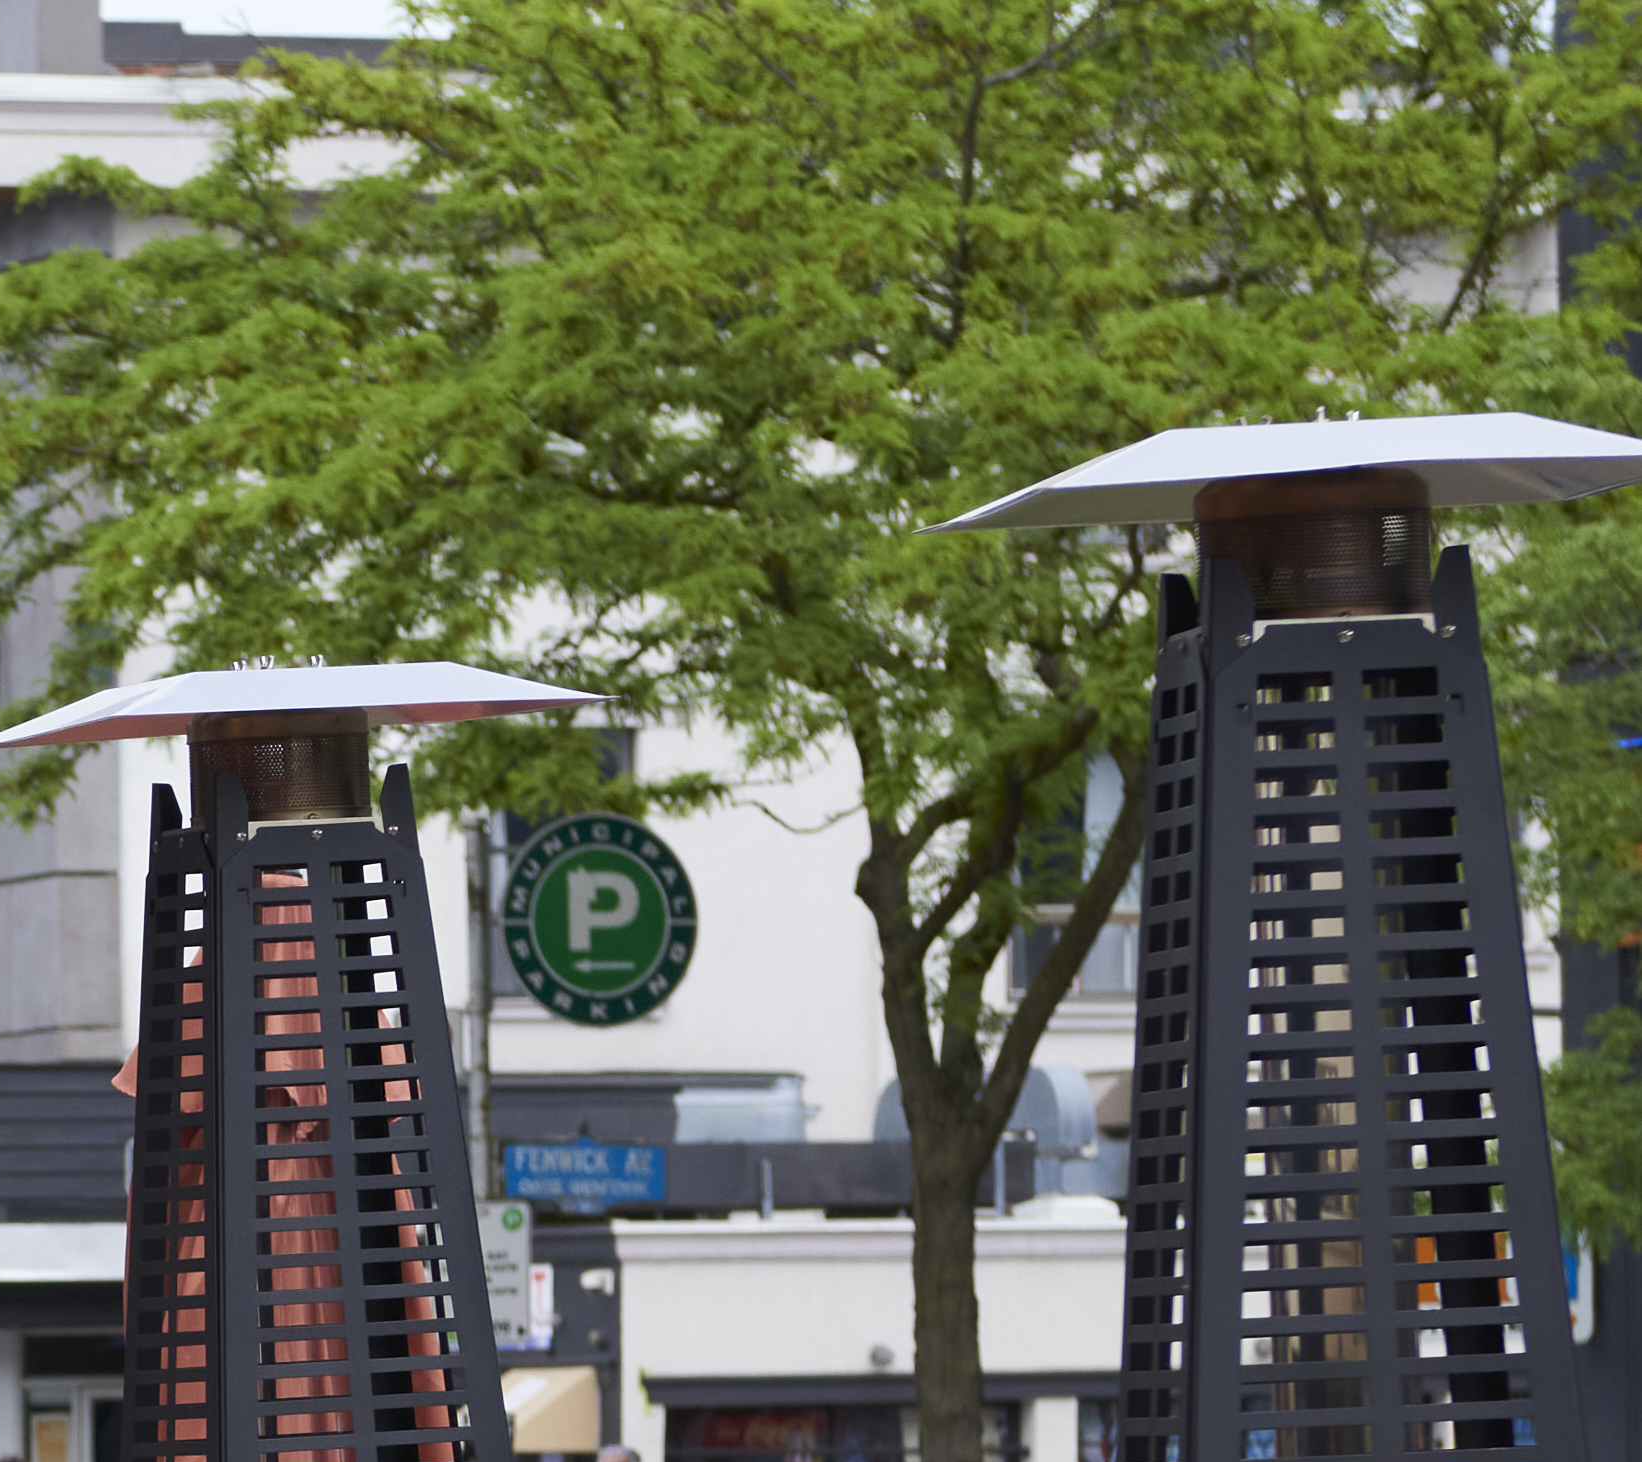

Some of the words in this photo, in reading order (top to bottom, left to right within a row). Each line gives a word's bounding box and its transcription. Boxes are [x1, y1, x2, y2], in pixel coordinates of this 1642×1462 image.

[510, 822, 688, 914] MUNICIPAL
[567, 867, 640, 951] P
[510, 937, 688, 1020] PARKING
